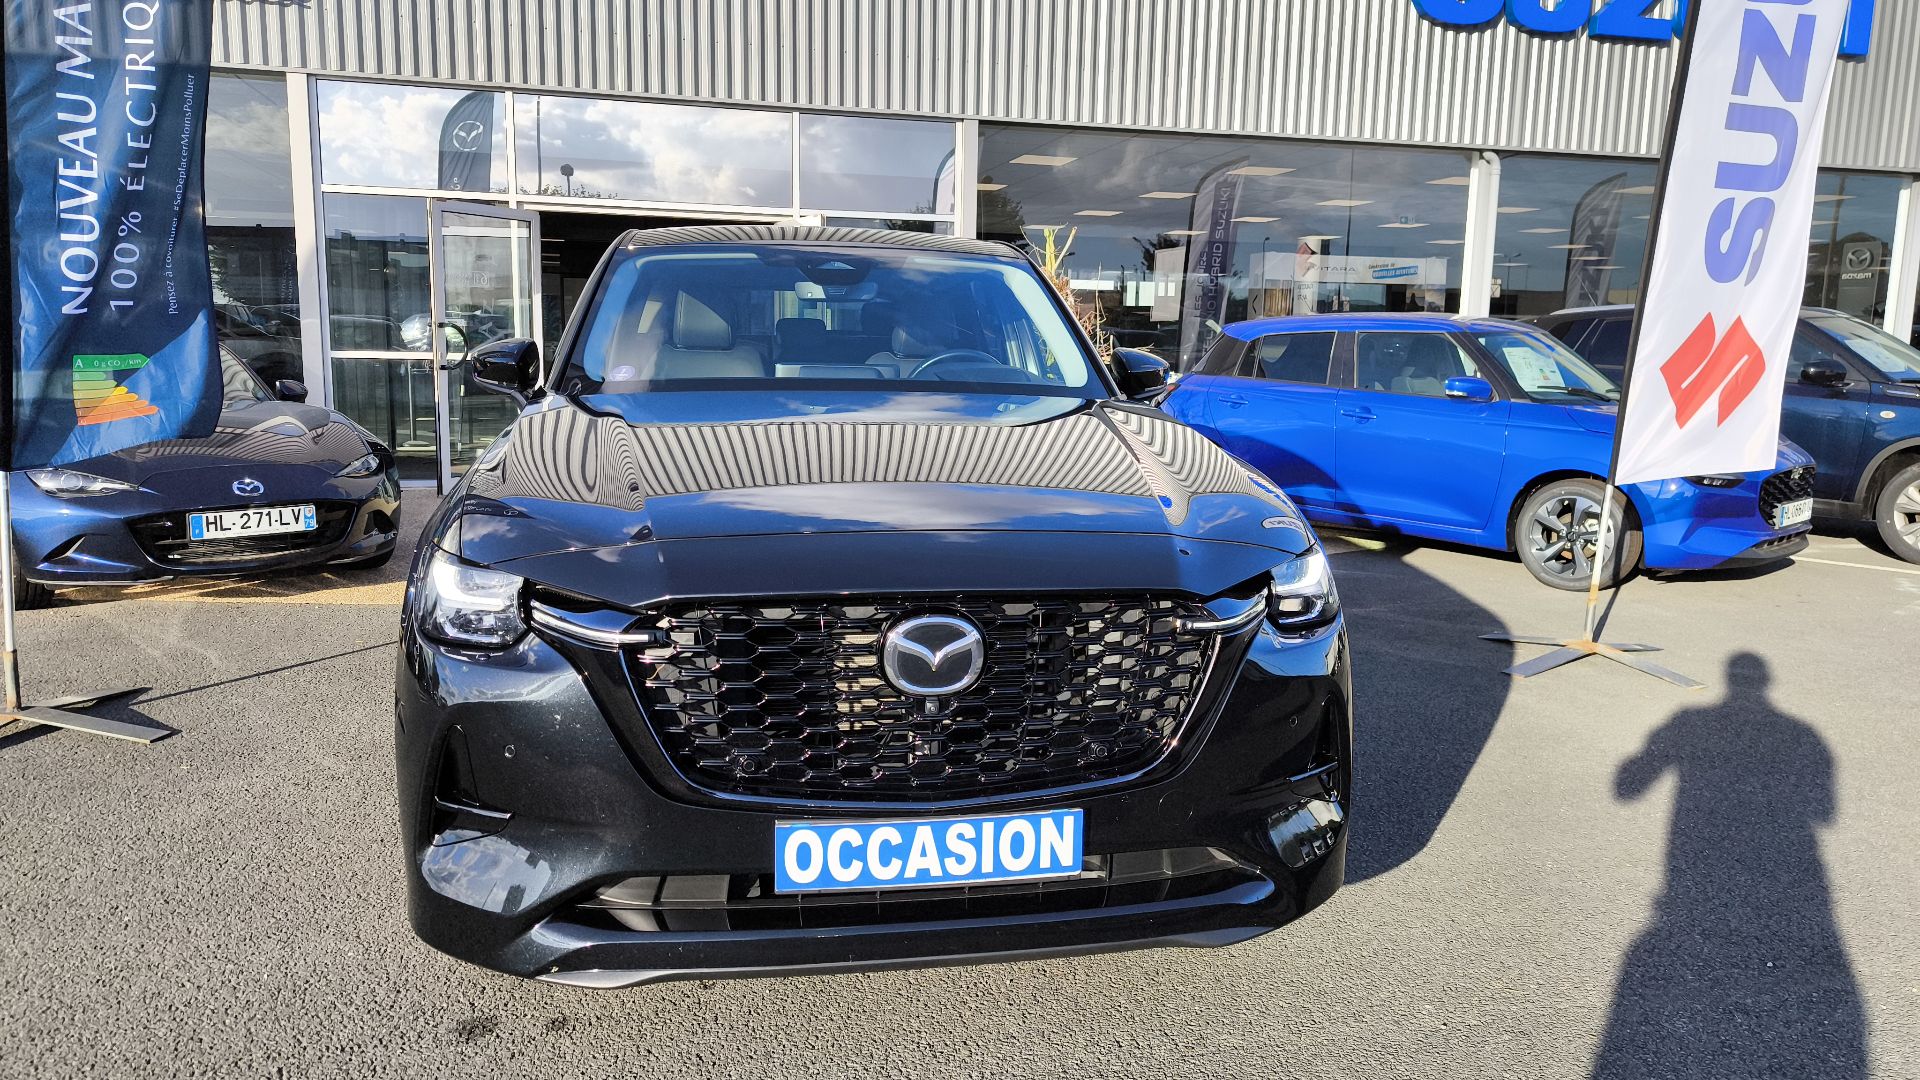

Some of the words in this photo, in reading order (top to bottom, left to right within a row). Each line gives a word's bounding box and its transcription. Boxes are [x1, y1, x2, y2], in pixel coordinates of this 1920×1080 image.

[119, 1, 160, 191] ÉLECTRIQ
[1704, 0, 1818, 287] SUZ
[55, 92, 100, 315] NOUVEAU
[1215, 187, 1231, 239] SUZUKI
[109, 211, 142, 311] 100%
[1208, 243, 1223, 297] HYBRID
[166, 280, 179, 315] Pensez
[74, 358, 84, 369] A
[205, 508, 301, 533] HL-271-LV
[304, 518, 314, 528] 79
[784, 815, 1075, 884] OCCASION
